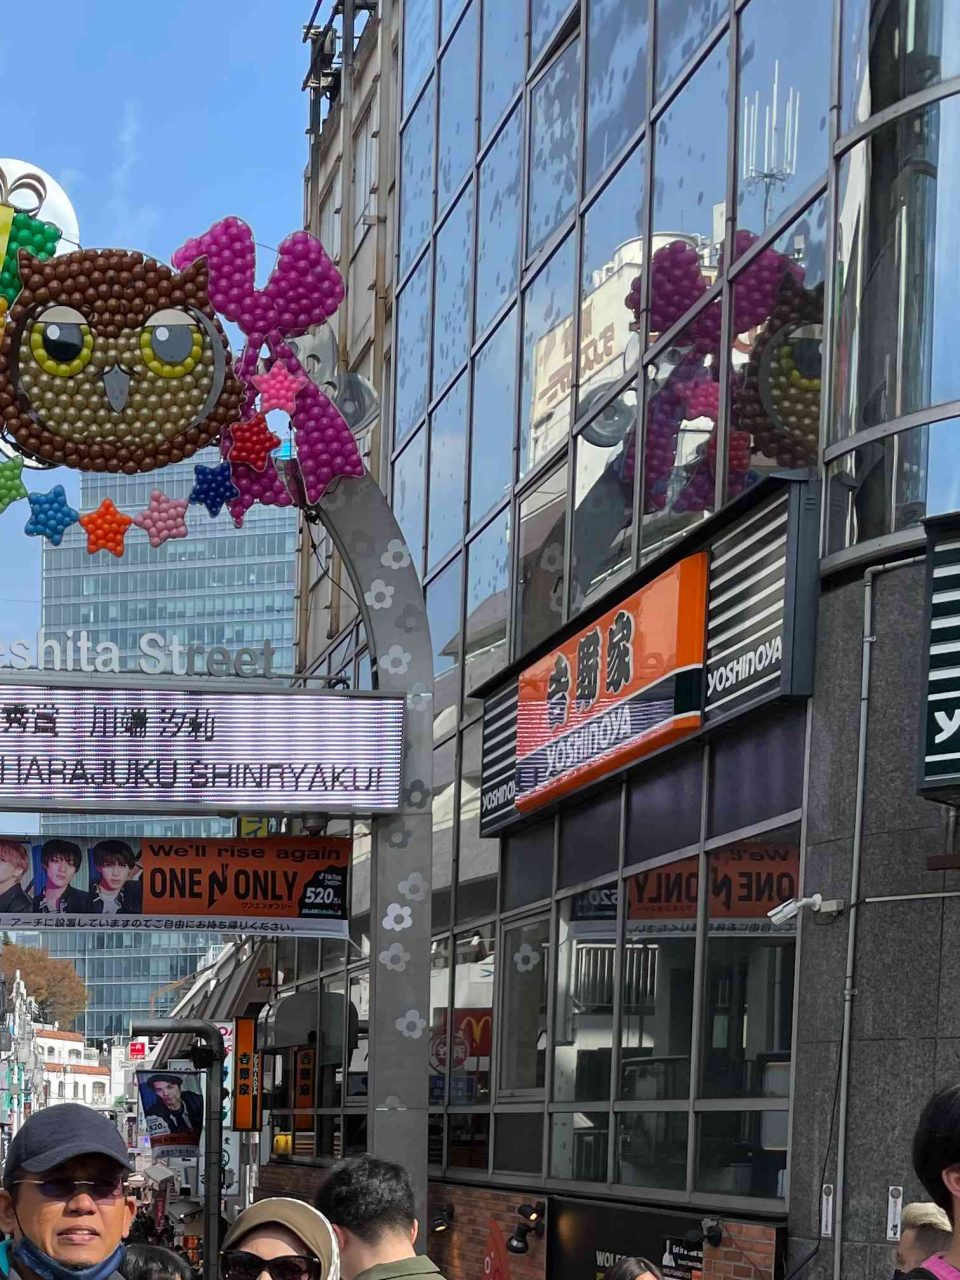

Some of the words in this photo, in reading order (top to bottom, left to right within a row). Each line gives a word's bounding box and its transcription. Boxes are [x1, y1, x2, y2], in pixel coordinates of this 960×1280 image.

[139, 631, 277, 680] Street
[707, 635, 782, 697] YOSHINOYA
[546, 703, 632, 777] YOSHINOYA
[149, 844, 207, 858] We'll
[217, 844, 266, 859] rise
[275, 846, 341, 864] again
[149, 867, 203, 899] ONE
[233, 868, 299, 901] ONLY
[304, 887, 334, 904] 520
